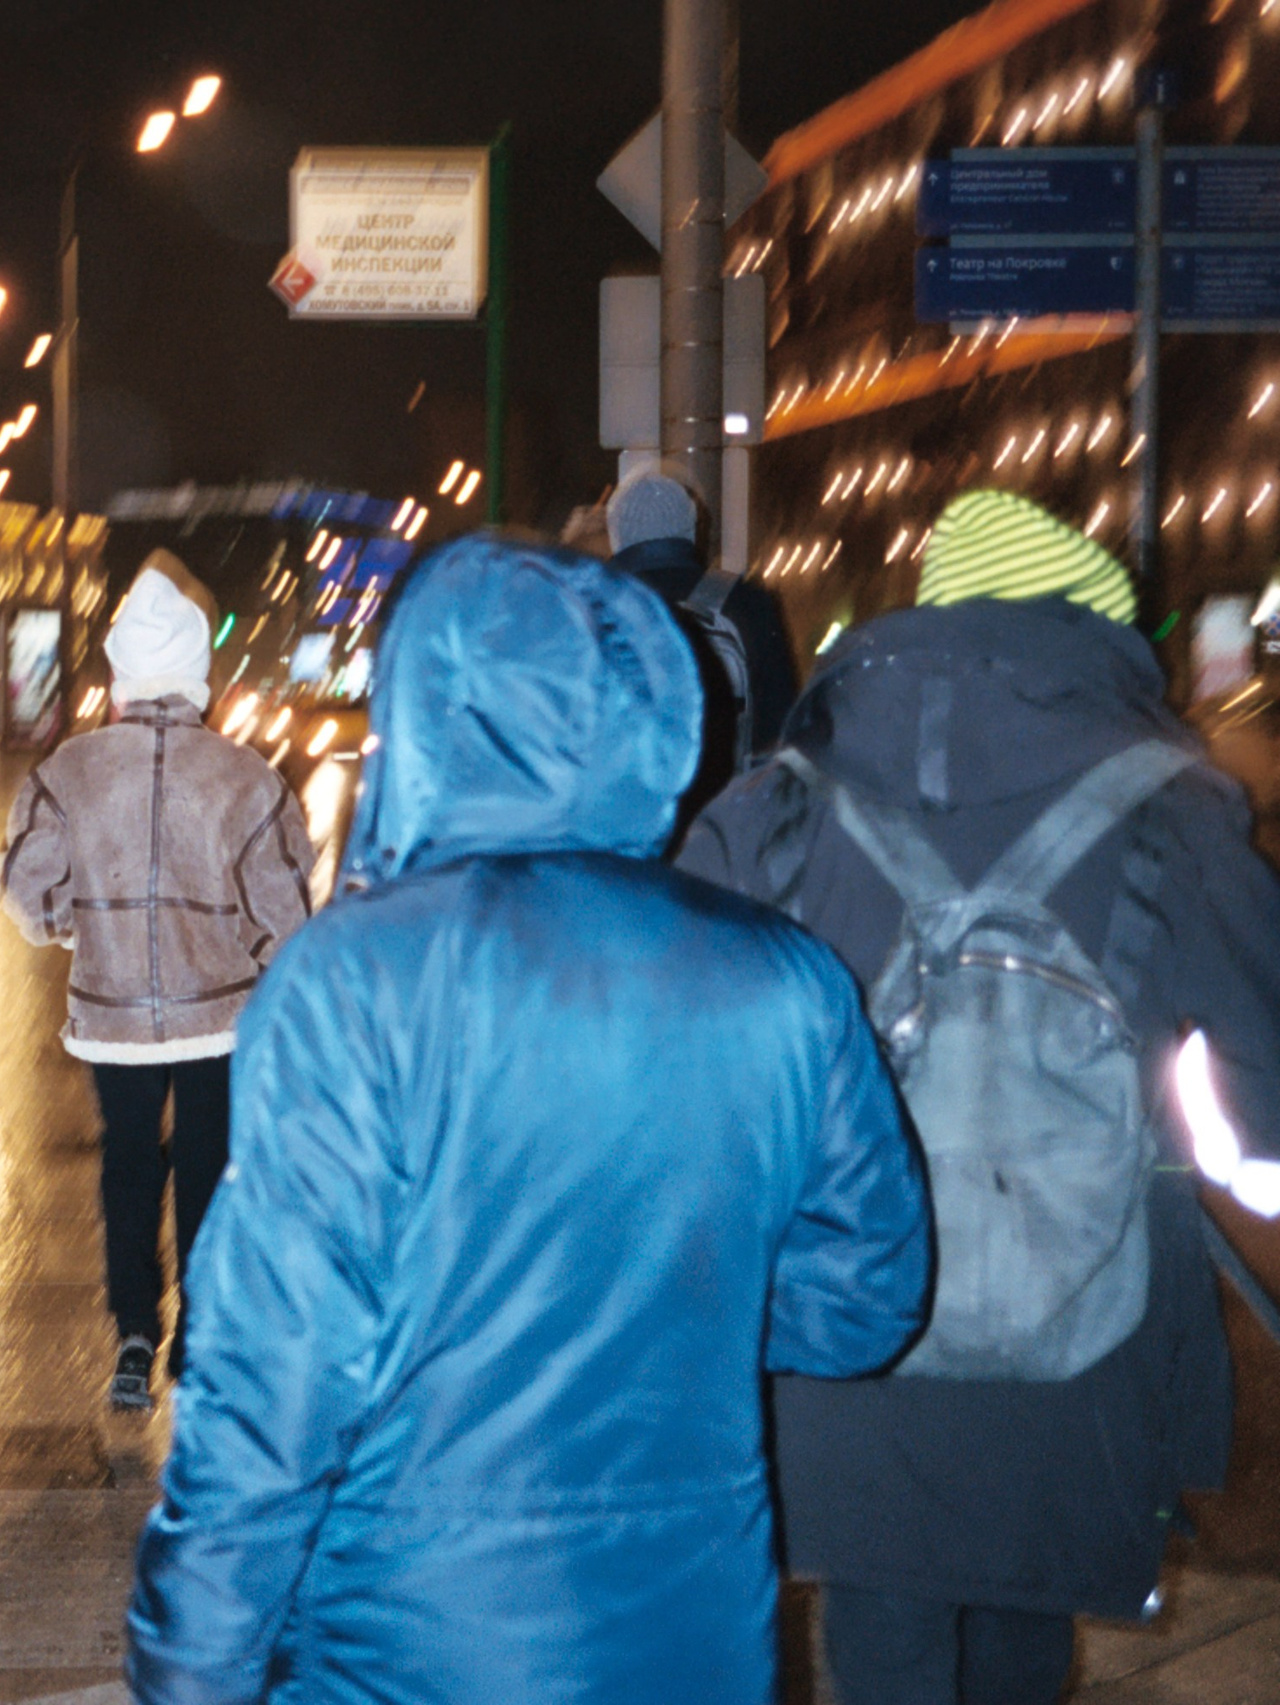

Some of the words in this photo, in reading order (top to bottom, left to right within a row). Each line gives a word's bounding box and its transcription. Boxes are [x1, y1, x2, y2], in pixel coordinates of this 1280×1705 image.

[357, 213, 414, 231] ЦЕНТР
[315, 232, 456, 252] МЕДИЦИНСКОЙ
[331, 256, 442, 274] ИНСПЕКЦИИ
[949, 257, 984, 271] Театр
[986, 260, 1002, 269] на
[1004, 257, 1066, 271] Покровке
